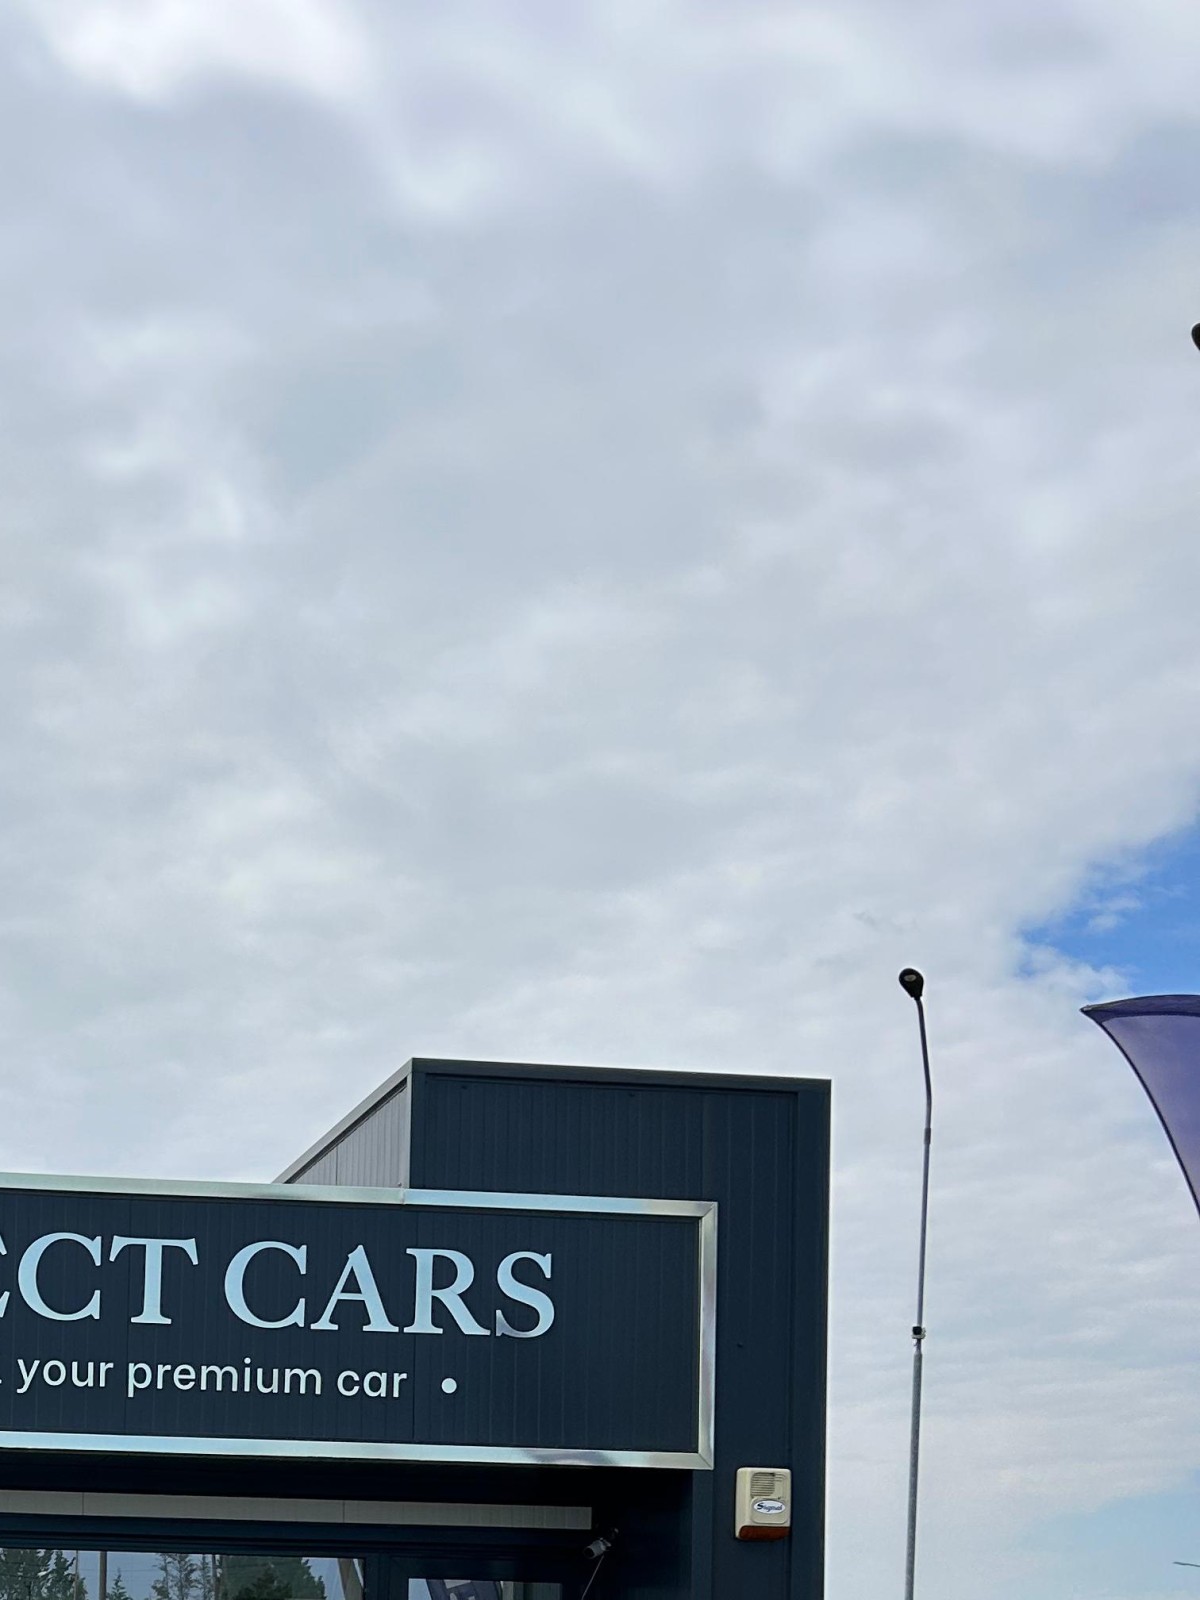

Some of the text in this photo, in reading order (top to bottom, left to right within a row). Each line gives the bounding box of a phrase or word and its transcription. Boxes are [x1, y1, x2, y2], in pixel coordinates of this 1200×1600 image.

[224, 1240, 556, 1339] CARS
[16, 1357, 114, 1394] your
[127, 1357, 322, 1398] premium
[337, 1369, 408, 1398] car
